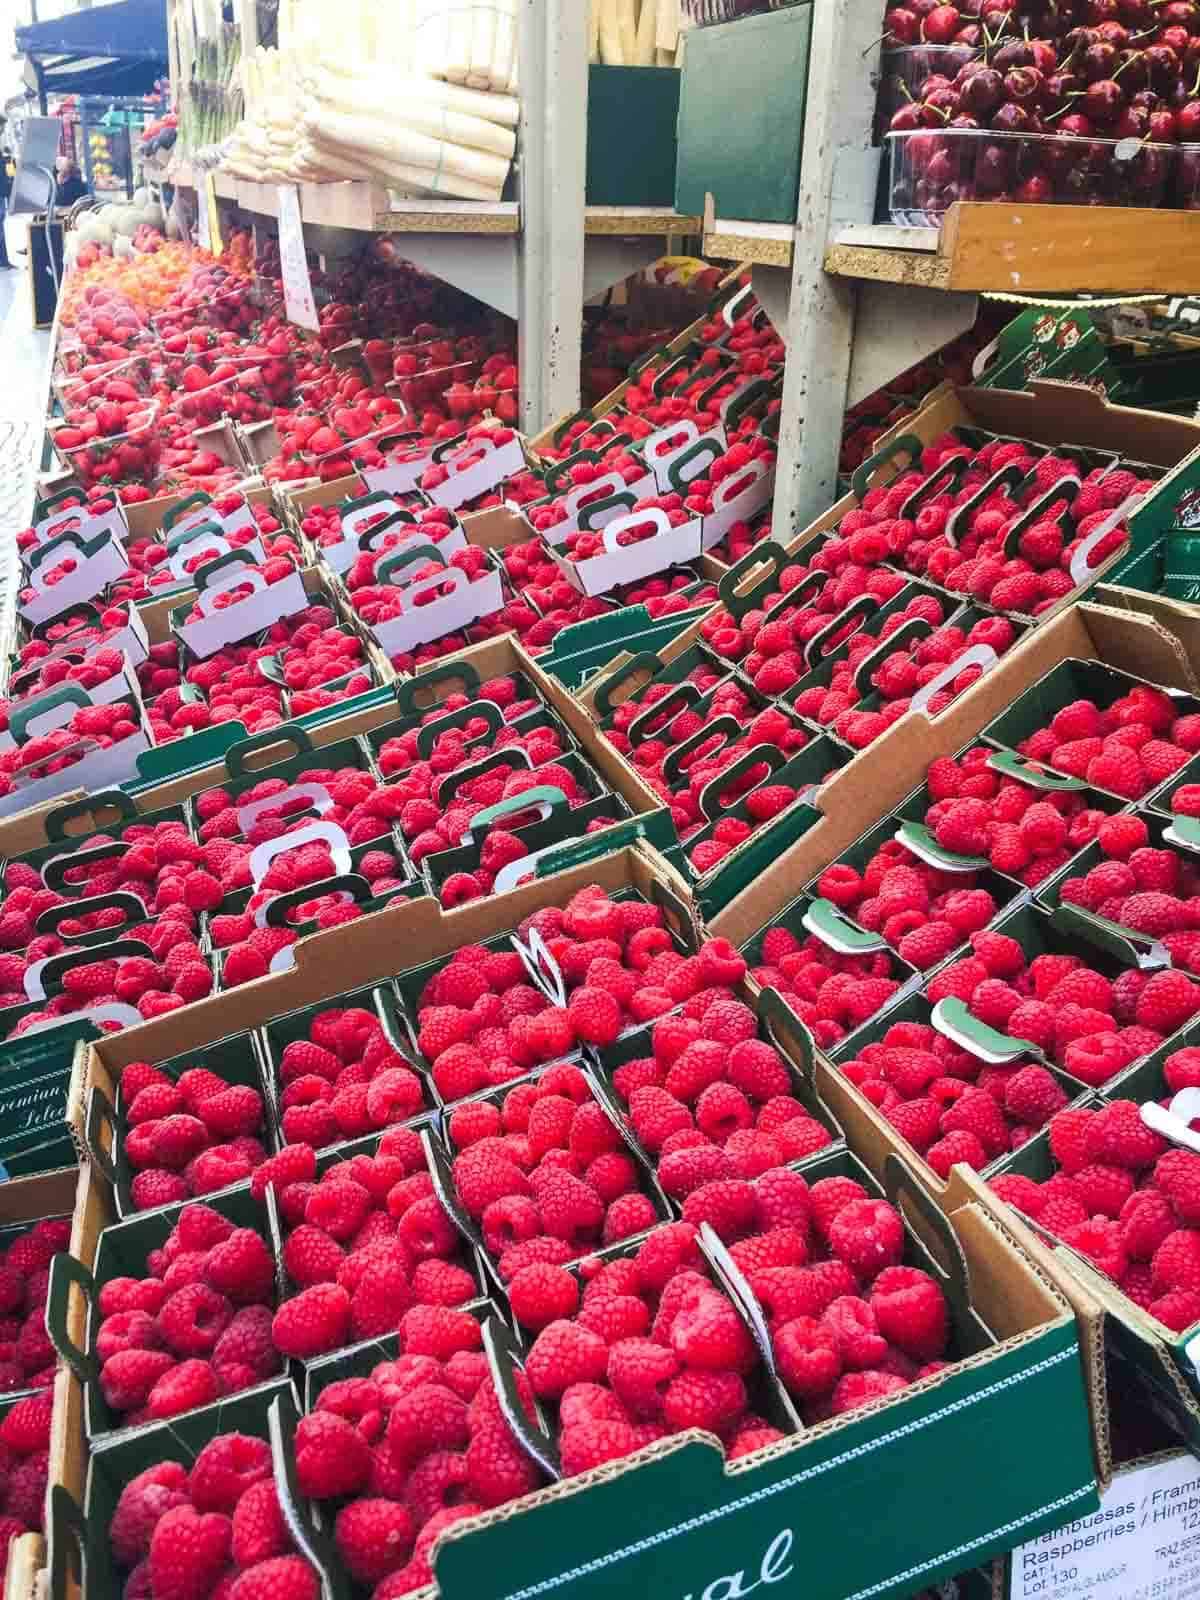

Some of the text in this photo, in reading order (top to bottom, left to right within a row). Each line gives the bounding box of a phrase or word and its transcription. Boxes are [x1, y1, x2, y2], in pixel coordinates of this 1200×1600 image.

[683, 1528, 794, 1600] al
[1023, 1520, 1136, 1569] Raspberries
[1051, 1567, 1078, 1585] 130
